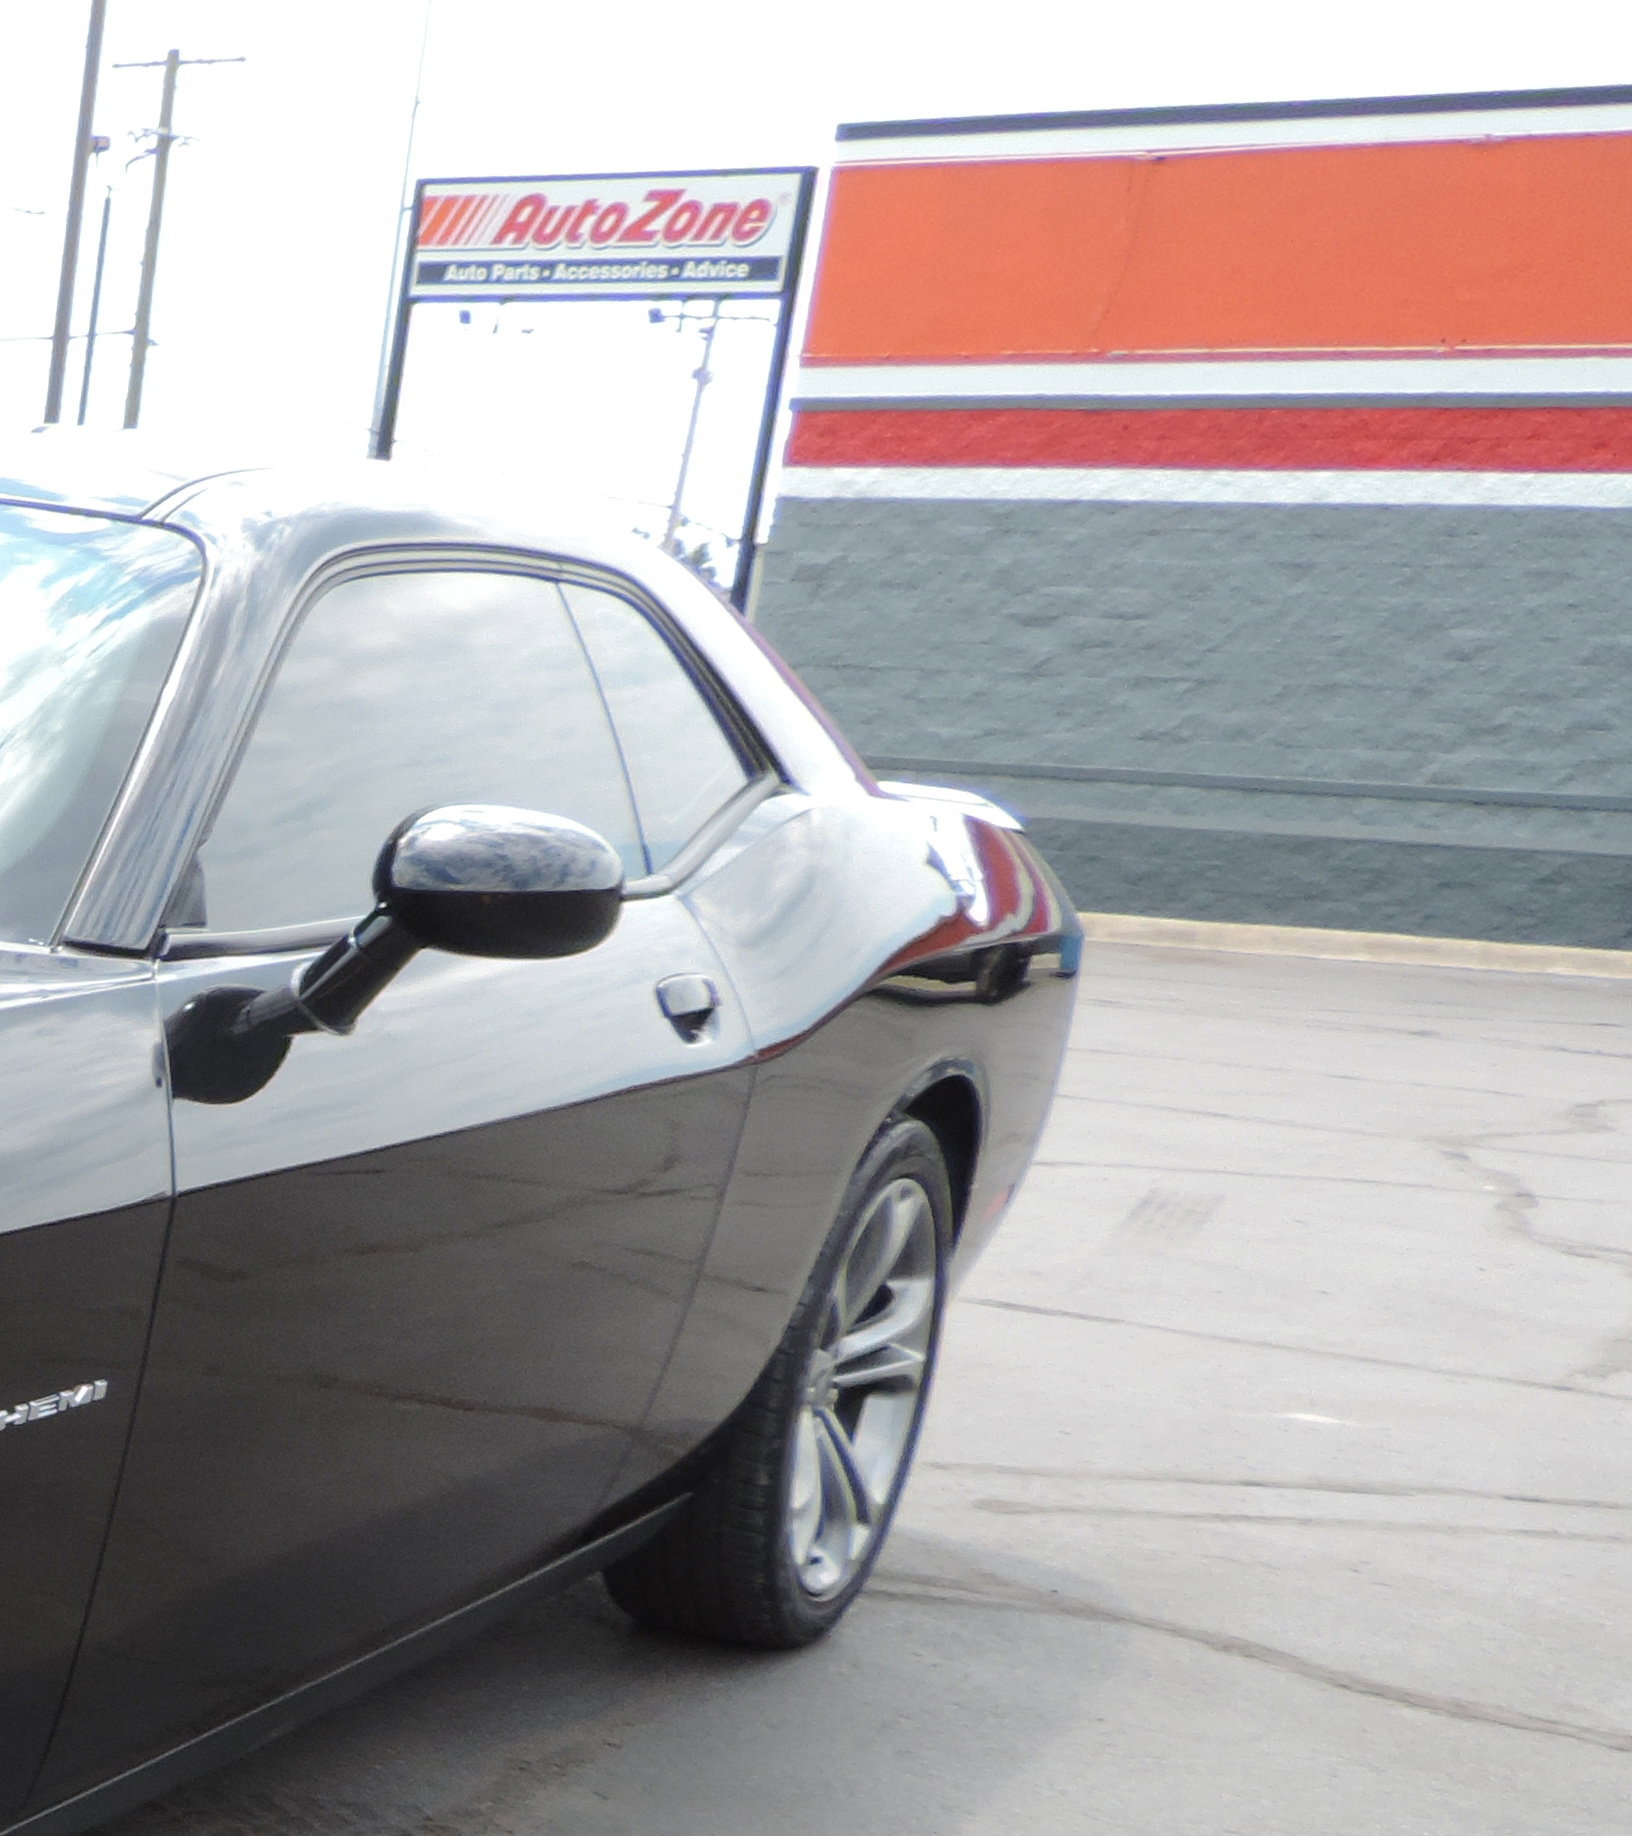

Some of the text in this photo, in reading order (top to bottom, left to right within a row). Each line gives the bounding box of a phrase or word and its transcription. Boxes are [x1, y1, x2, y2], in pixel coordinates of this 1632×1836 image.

[491, 188, 774, 248] AutoZone
[443, 260, 750, 281] Auto Parts Accessories Advice
